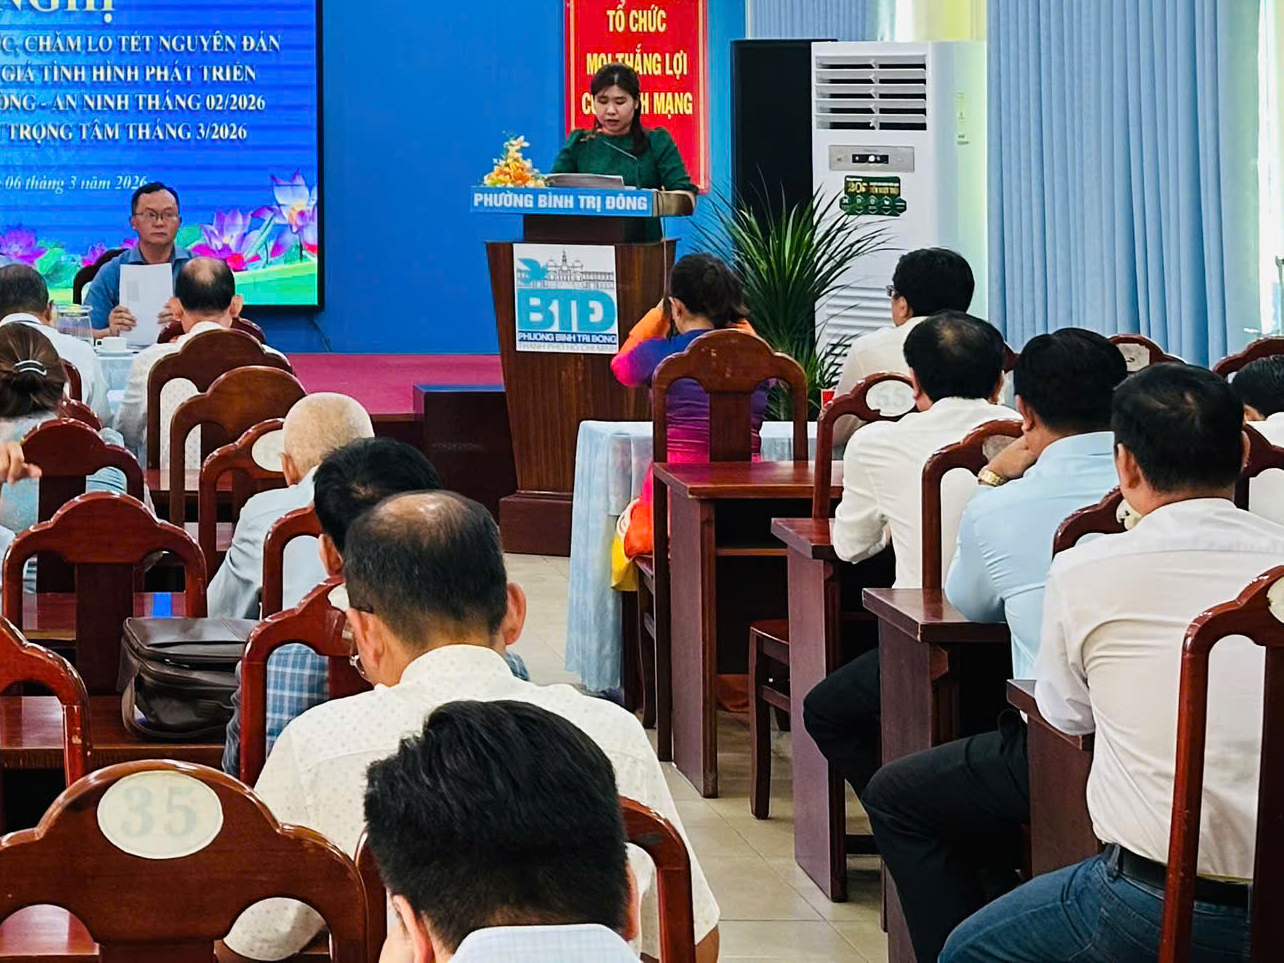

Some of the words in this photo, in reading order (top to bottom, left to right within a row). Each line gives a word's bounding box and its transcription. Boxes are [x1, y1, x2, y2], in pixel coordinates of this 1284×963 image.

[629, 4, 666, 32] CHỨC
[25, 30, 81, 52] CHĂM
[87, 35, 113, 52] LO
[159, 30, 236, 52] NGUYÊN
[241, 30, 280, 52] ĐÁN
[0, 60, 34, 81] GIÁ
[41, 64, 86, 82] TÌNH
[91, 64, 139, 82] HÌNH
[145, 60, 193, 81] PHÁT
[665, 50, 688, 79] LỢI
[52, 94, 78, 111] AN
[83, 94, 129, 111] NINH
[135, 90, 201, 111] THÁNG
[206, 93, 265, 112] 02/2026
[654, 92, 693, 119] MẠNG
[7, 123, 73, 144] TRỌNG
[79, 119, 120, 140] TÂM
[125, 119, 191, 140] THÁNG
[196, 123, 247, 140] 3/2026
[5, 176, 22, 190] 06
[25, 175, 65, 194] tháng
[68, 176, 77, 190] 3
[80, 176, 111, 190] năm
[473, 190, 534, 208] PHƯỜNG
[537, 191, 574, 209] BÌNH
[578, 195, 601, 212] TRỊ
[605, 193, 648, 211] ĐÔNG
[122, 785, 196, 837] 35
